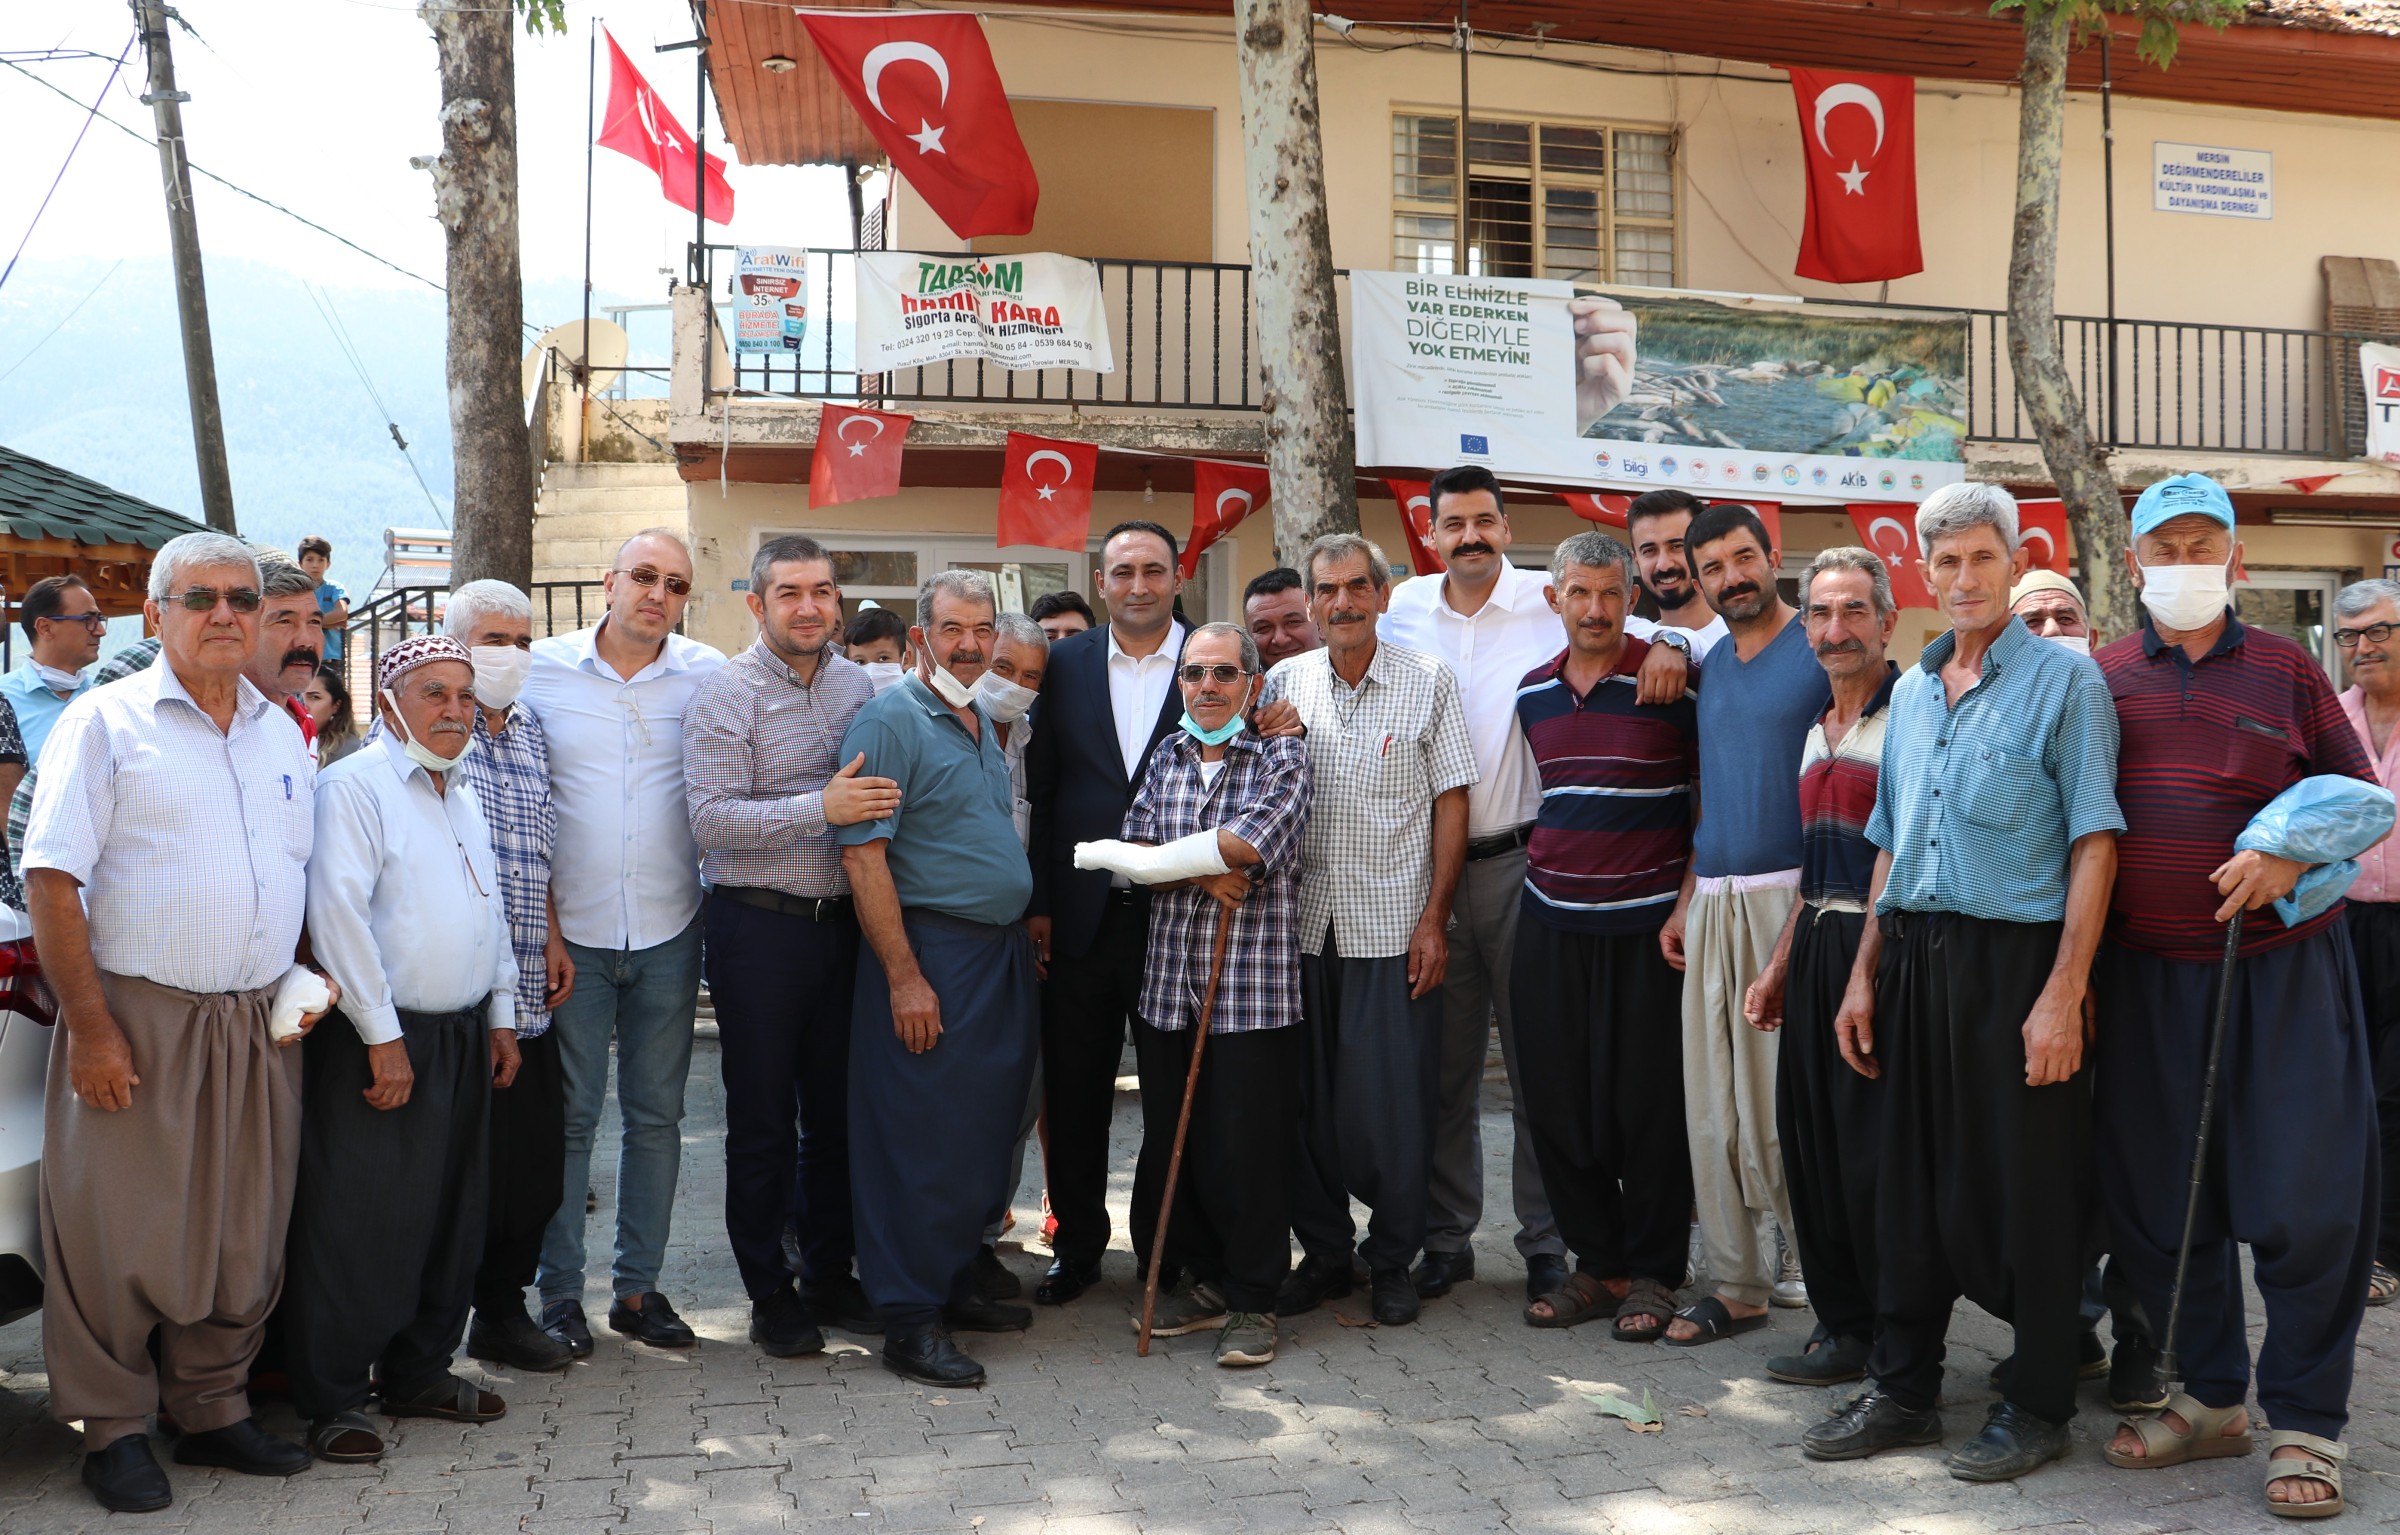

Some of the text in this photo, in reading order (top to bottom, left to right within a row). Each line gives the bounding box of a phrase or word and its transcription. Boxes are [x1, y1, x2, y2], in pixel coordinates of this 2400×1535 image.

[2159, 178, 2193, 192] KÜLTÜR
[2195, 183, 2256, 200] YARDIMLAŞMA
[2169, 196, 2218, 212] DAYANIŞMA
[741, 252, 805, 268] AratWifi
[753, 284, 789, 294] İNTERNET
[1406, 278, 1529, 306] BİR ELİNİZLE
[991, 301, 1061, 326] KARA
[1407, 300, 1529, 323] VAR EDERKEN
[904, 311, 951, 330] Sigorta
[999, 323, 1064, 337] Hizmetleri
[1407, 315, 1530, 347] DİĞERİYLE
[881, 329, 976, 352] Tel: 0324 320 19 28 Cep:
[990, 341, 1003, 351] 560
[1006, 342, 1015, 351] 05
[1018, 340, 1027, 350] 84
[1034, 339, 1055, 348] 0539
[1056, 339, 1071, 347] 684
[1073, 340, 1083, 349] 50
[1408, 341, 1530, 365] YOK ETMEYİN!
[1623, 459, 1648, 477] bilgi
